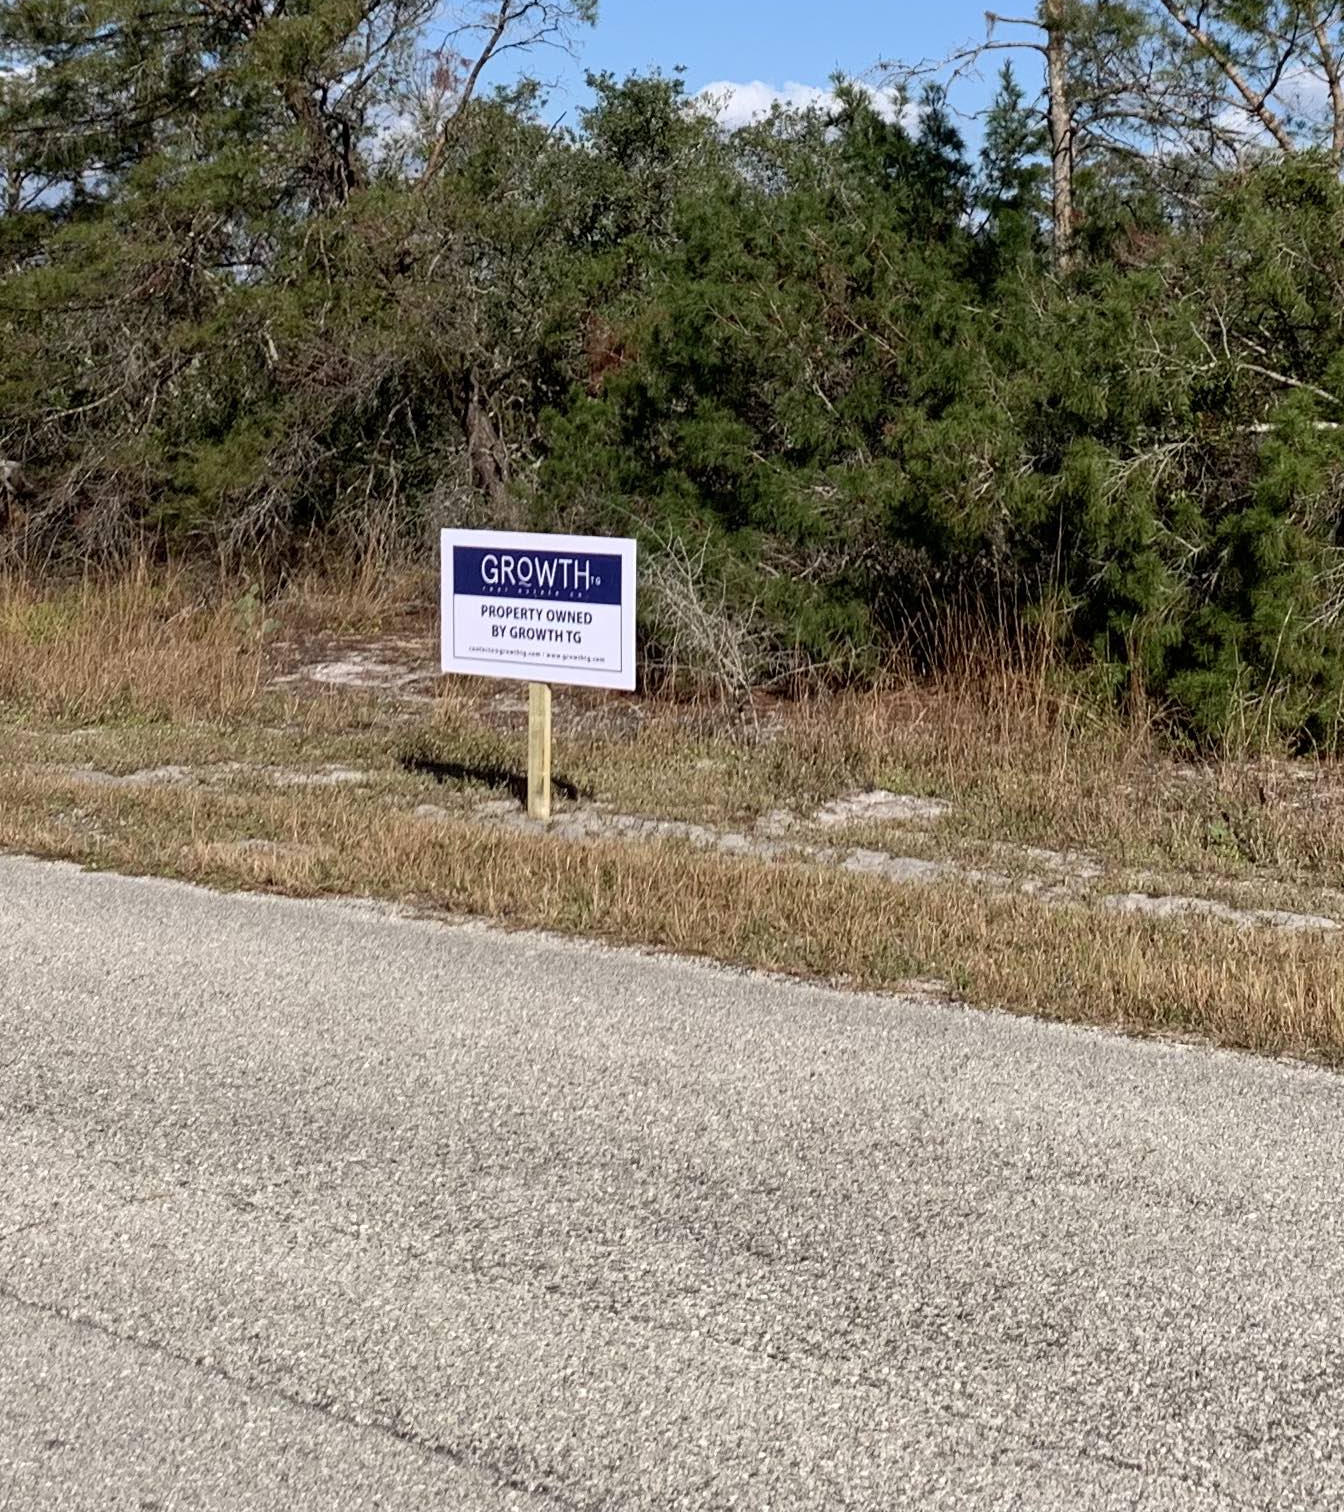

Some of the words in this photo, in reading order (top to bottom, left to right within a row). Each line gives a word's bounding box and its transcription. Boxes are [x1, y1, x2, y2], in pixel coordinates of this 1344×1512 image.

[481, 554, 590, 591] GROWTH
[480, 604, 544, 621] PROPERTY
[546, 609, 593, 625] OWNED
[491, 625, 506, 638] BY
[509, 626, 563, 643] GROWTH
[565, 630, 582, 644] TG
